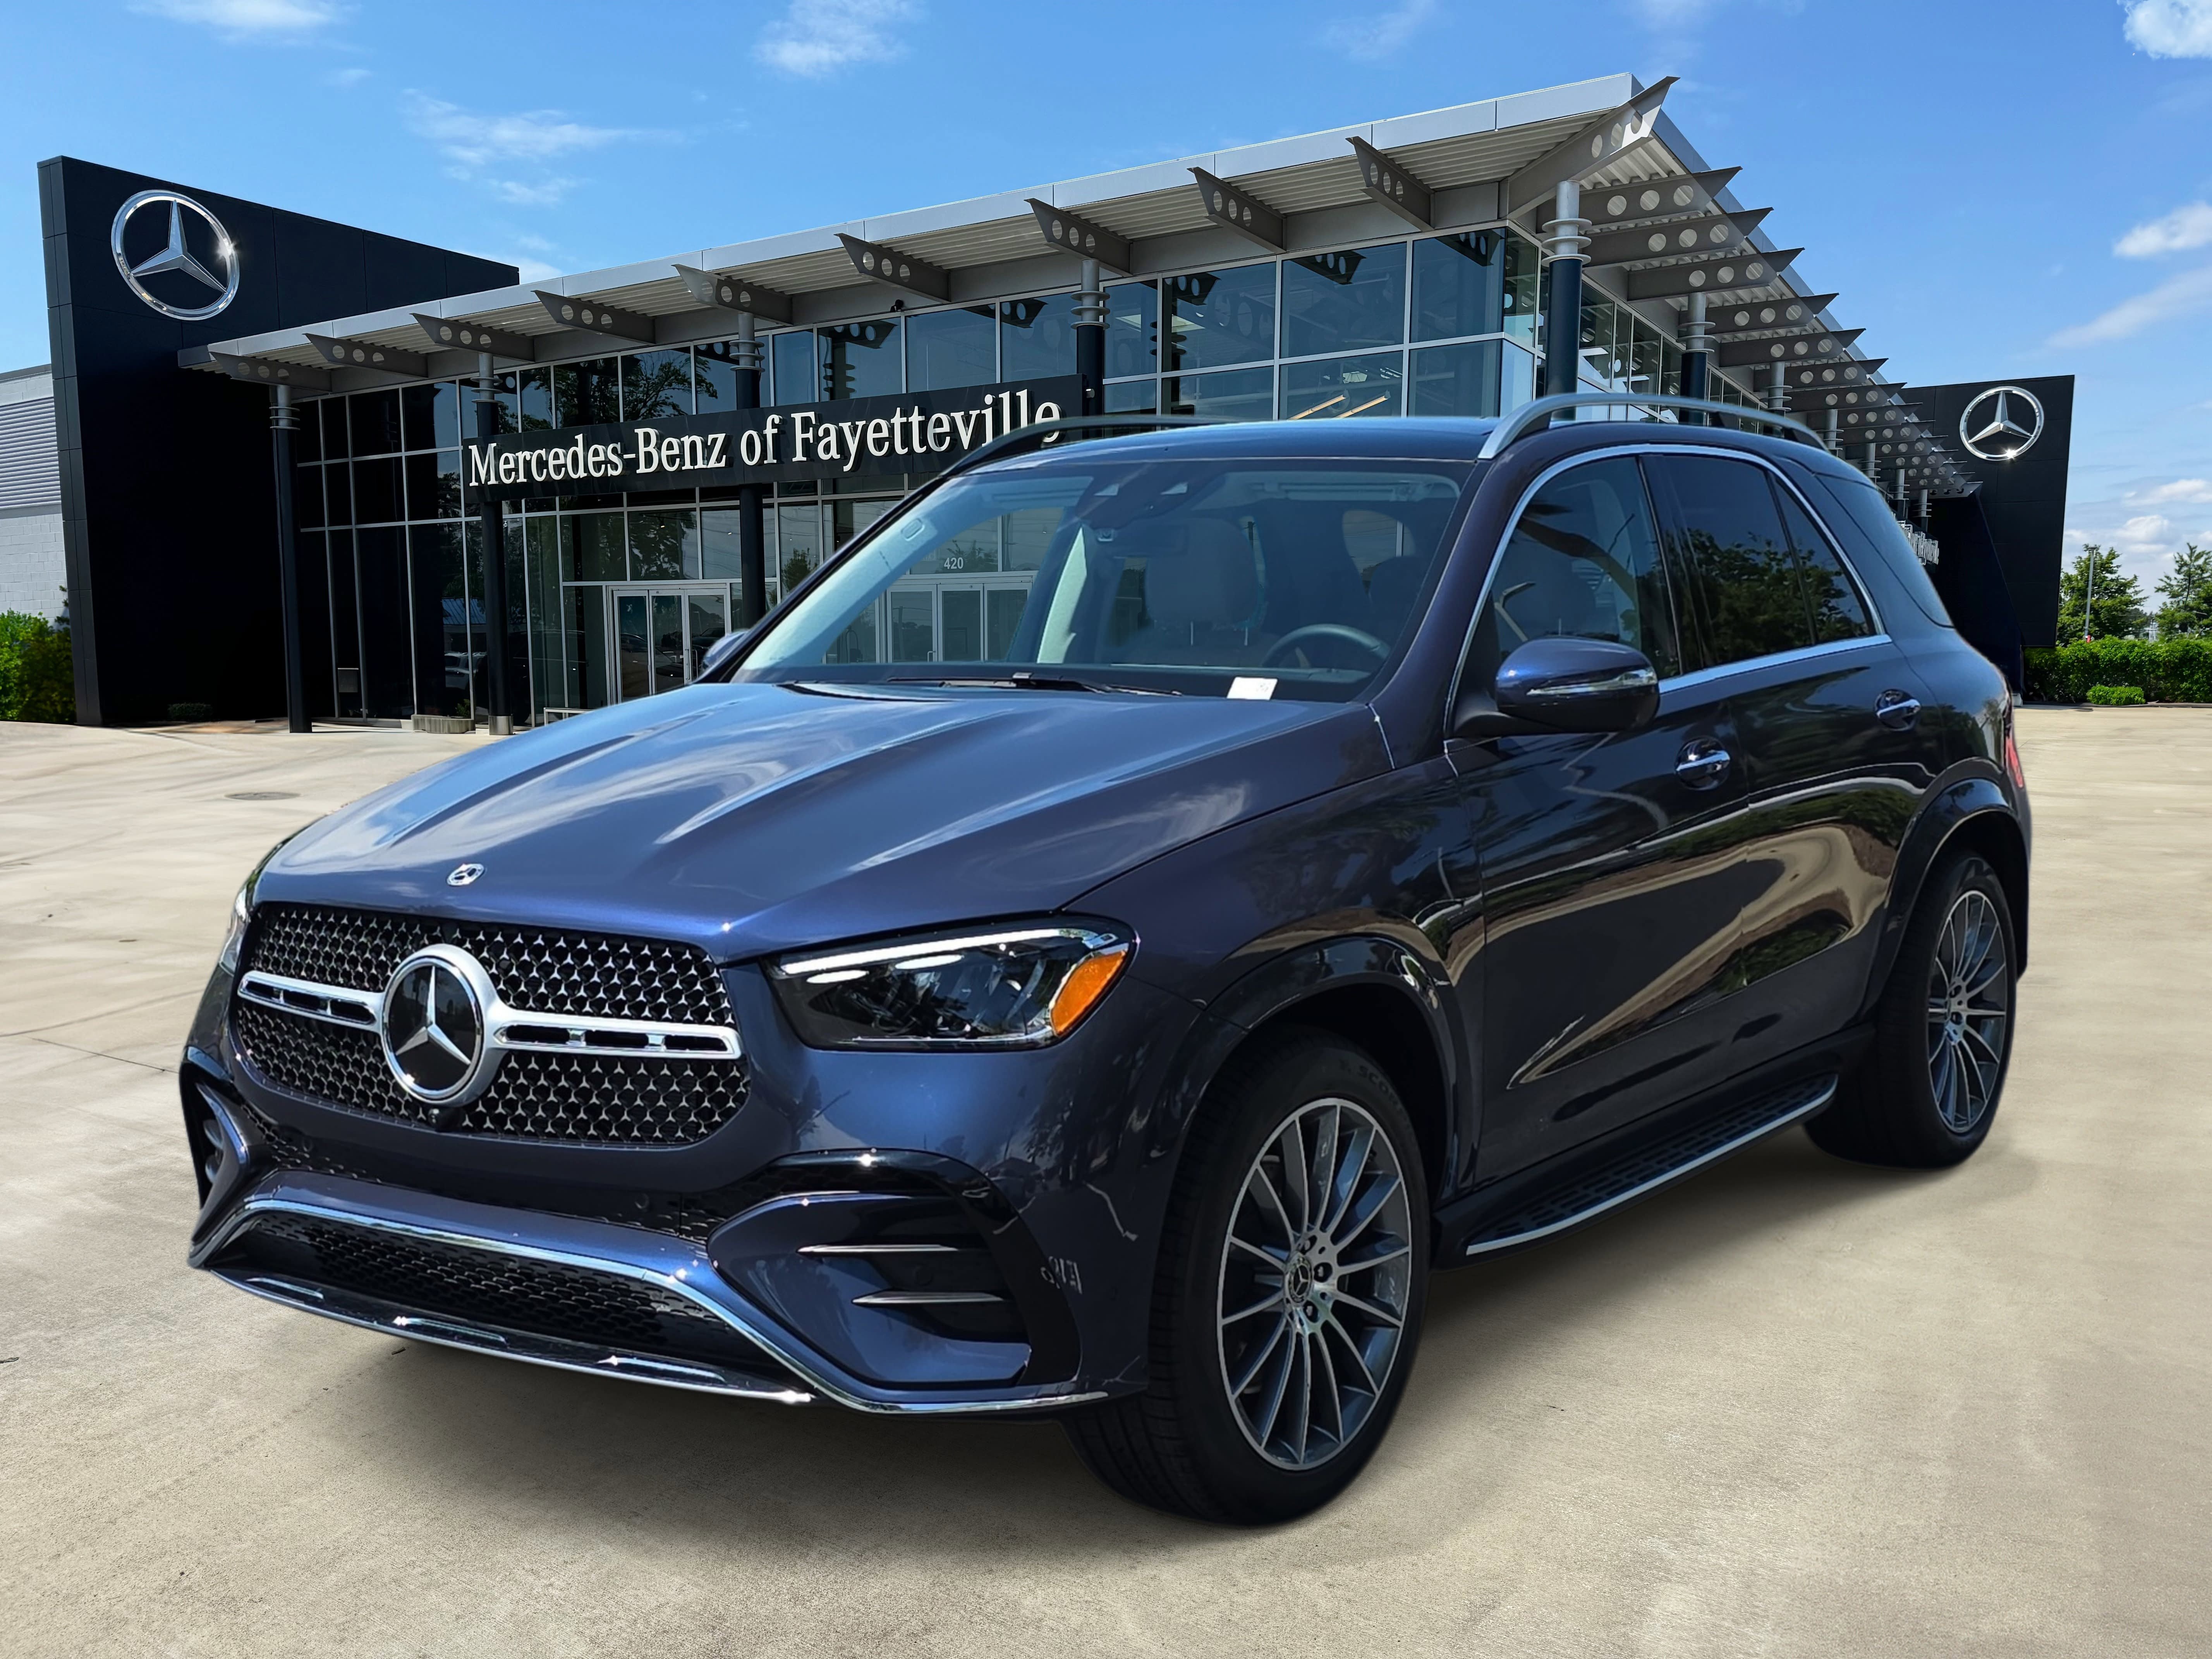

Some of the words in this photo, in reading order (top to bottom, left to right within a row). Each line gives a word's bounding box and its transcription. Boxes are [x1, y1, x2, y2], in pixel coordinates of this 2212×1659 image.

[469, 428, 726, 487] Mercedes-Benz
[740, 414, 783, 466] of
[791, 389, 1061, 472] Fayetteville
[944, 557, 963, 569] 420
